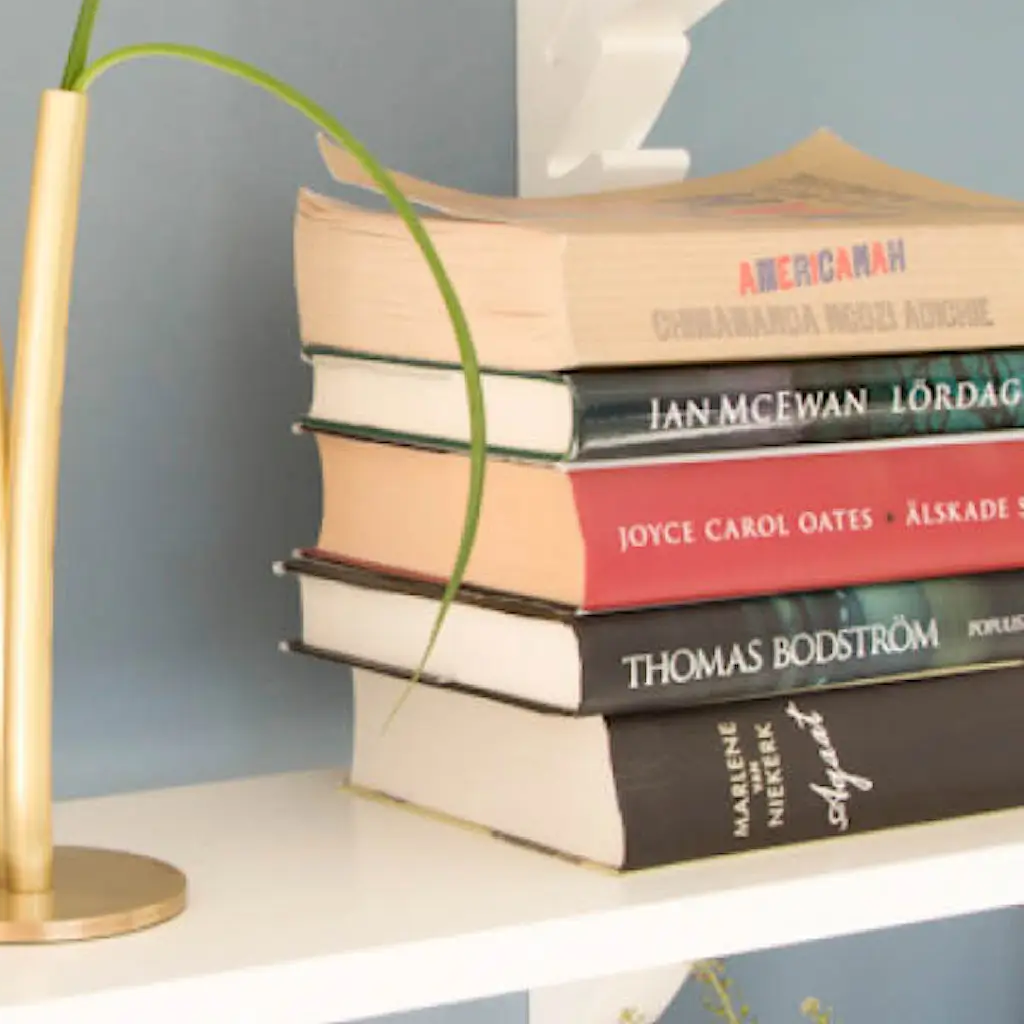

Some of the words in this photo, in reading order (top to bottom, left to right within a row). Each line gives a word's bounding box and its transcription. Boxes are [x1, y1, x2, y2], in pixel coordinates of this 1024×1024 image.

[739, 238, 906, 297] AMERICANAH
[649, 397, 711, 430] IAN
[891, 376, 1022, 414] LÖRDAG
[618, 521, 696, 552] JOYCE
[705, 512, 790, 540] CAROL
[799, 508, 874, 536] OATES
[905, 497, 1010, 527] ÄLSKADE
[622, 639, 763, 689] THOMAS
[772, 614, 940, 670] BODSTRÖM
[718, 721, 751, 838] MARLENE
[754, 721, 785, 827] NIEKERK
